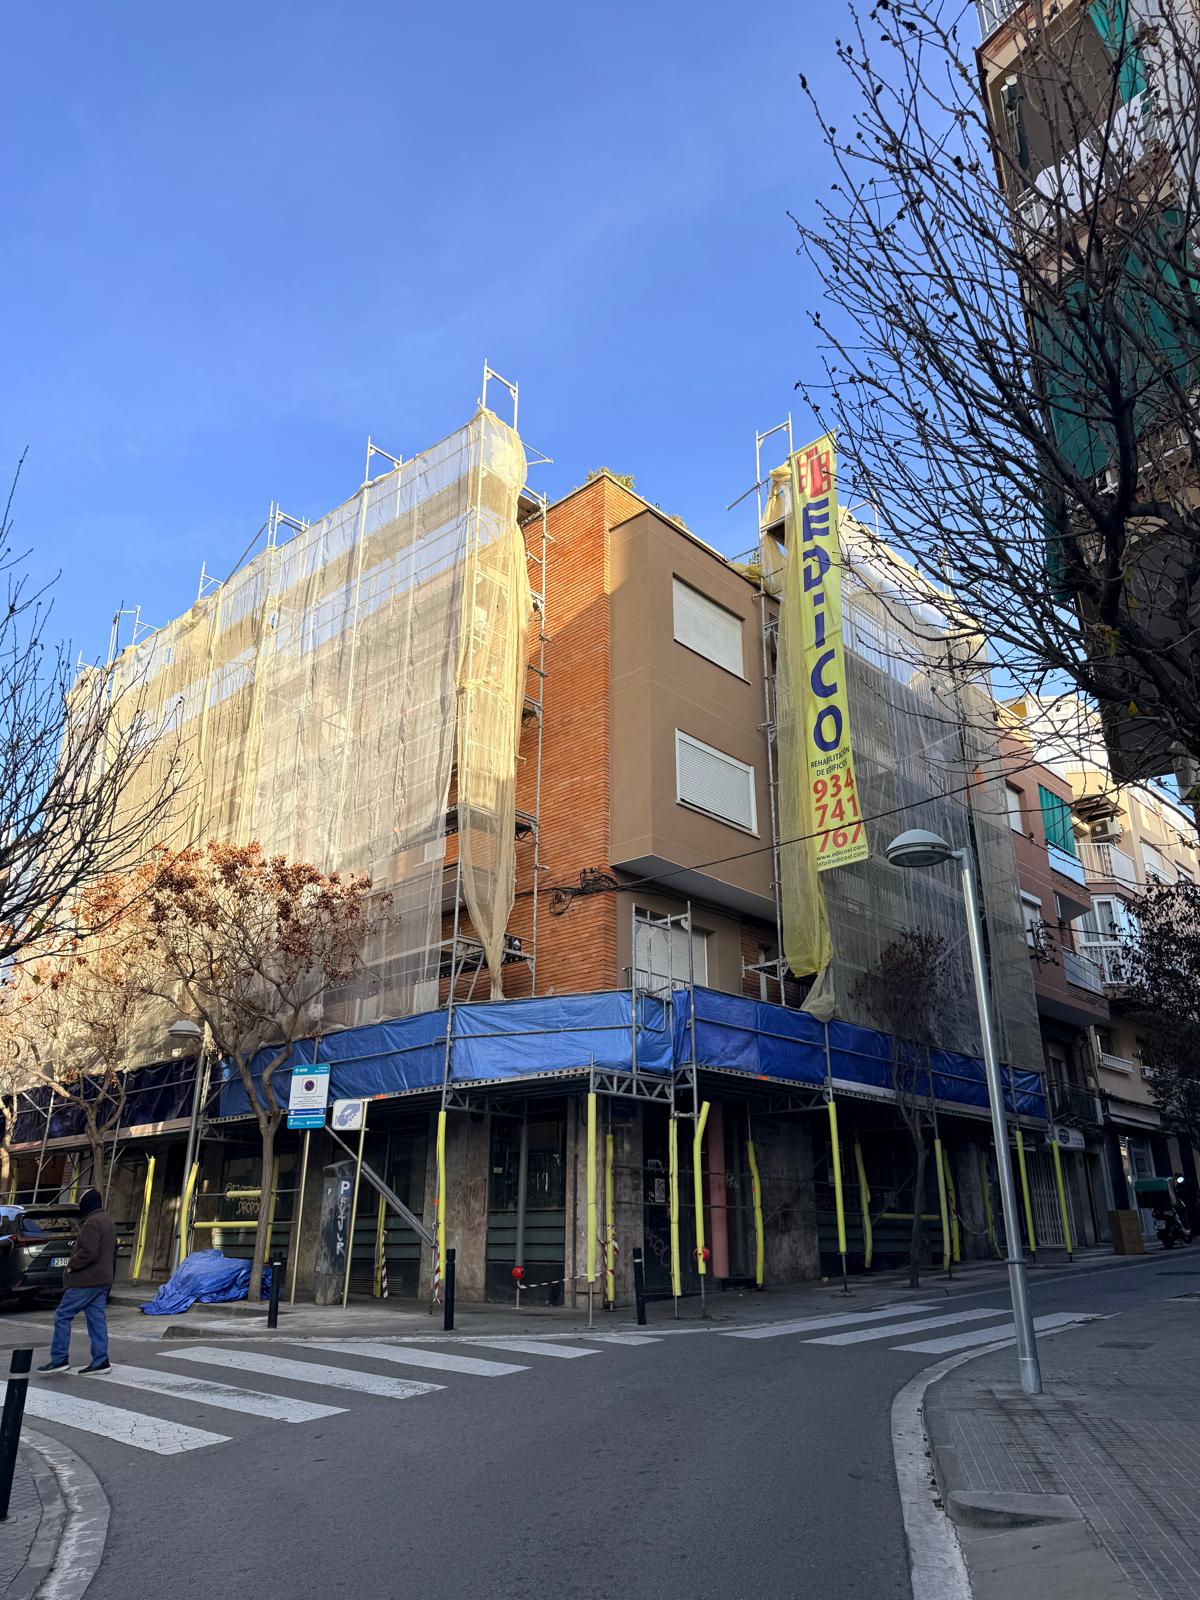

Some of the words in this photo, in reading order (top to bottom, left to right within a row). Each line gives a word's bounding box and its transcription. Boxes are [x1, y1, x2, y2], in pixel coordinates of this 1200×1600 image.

[813, 767, 854, 803] 934
[816, 768, 825, 777] DE
[815, 794, 858, 828] 741
[816, 819, 862, 853] 767
[340, 1181, 350, 1195] P
